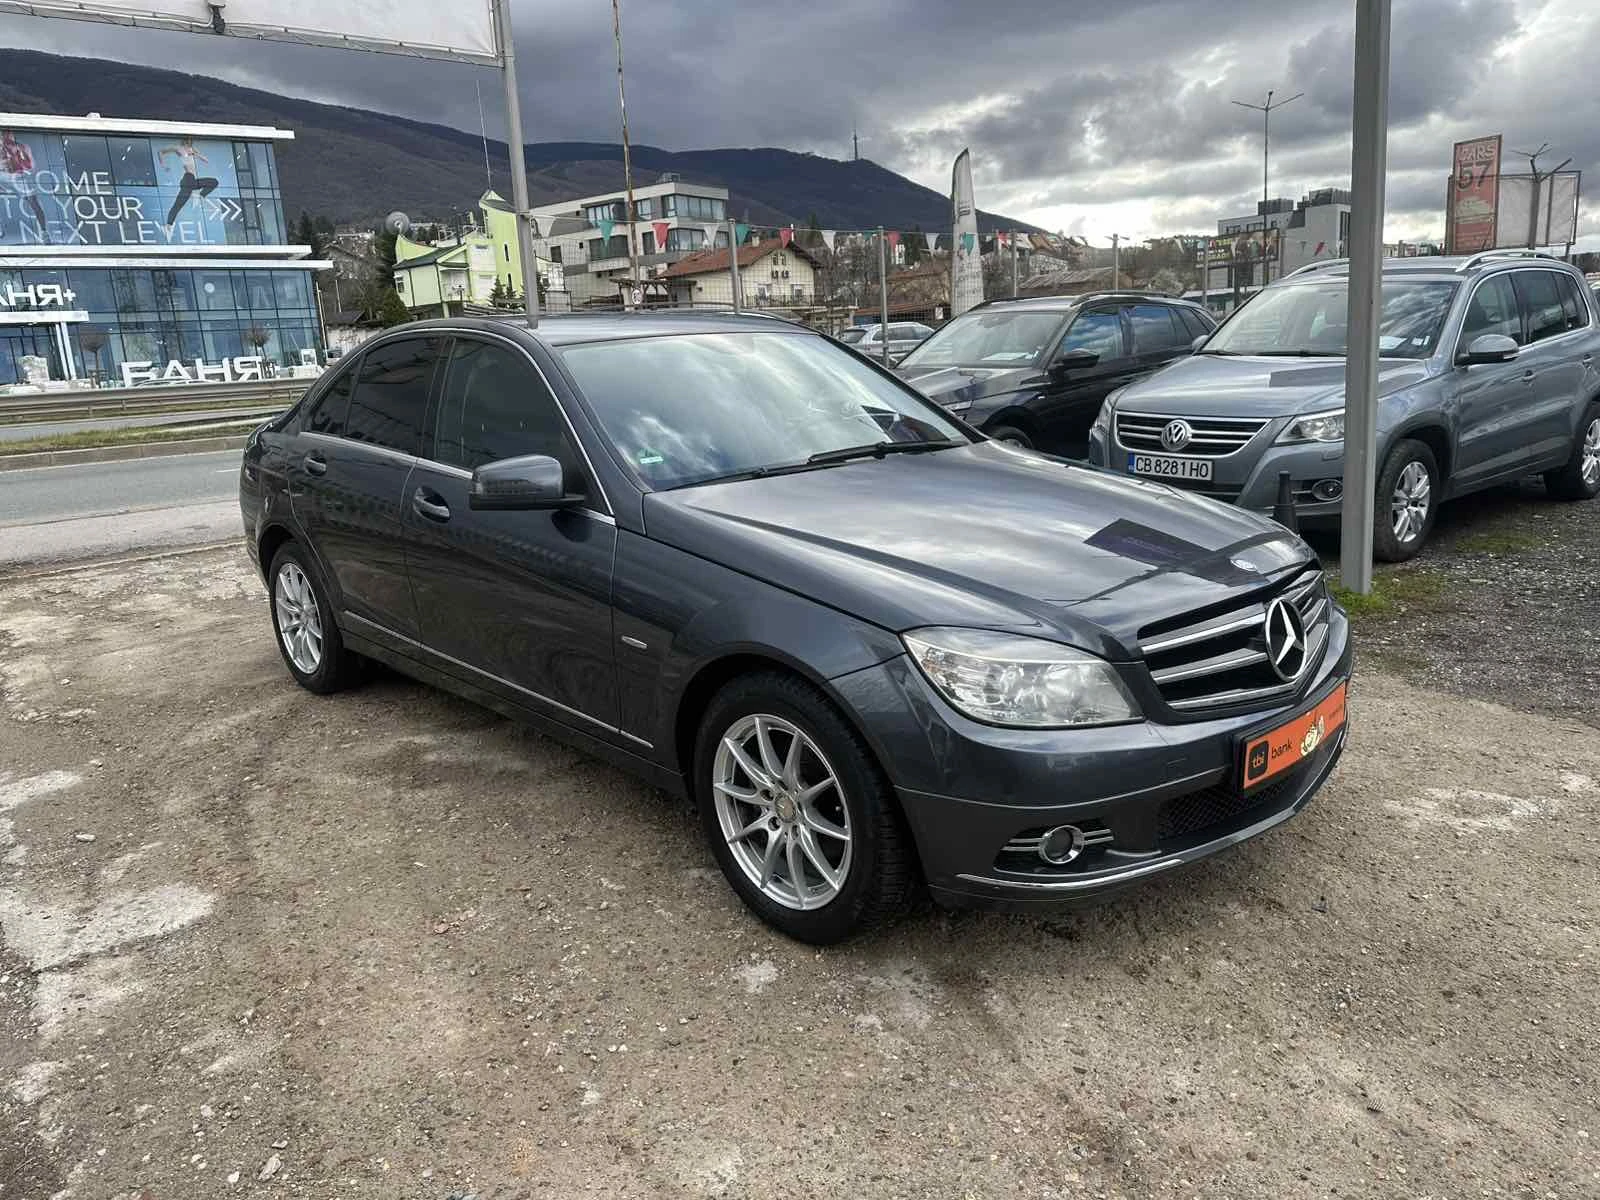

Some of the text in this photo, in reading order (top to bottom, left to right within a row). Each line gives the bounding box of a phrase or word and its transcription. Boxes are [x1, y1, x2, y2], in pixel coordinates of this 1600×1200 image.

[52, 195, 145, 220] YOUR
[19, 220, 216, 244] NEXT LEVEL
[1154, 459, 1187, 476] 8281
[1271, 737, 1293, 759] bank
